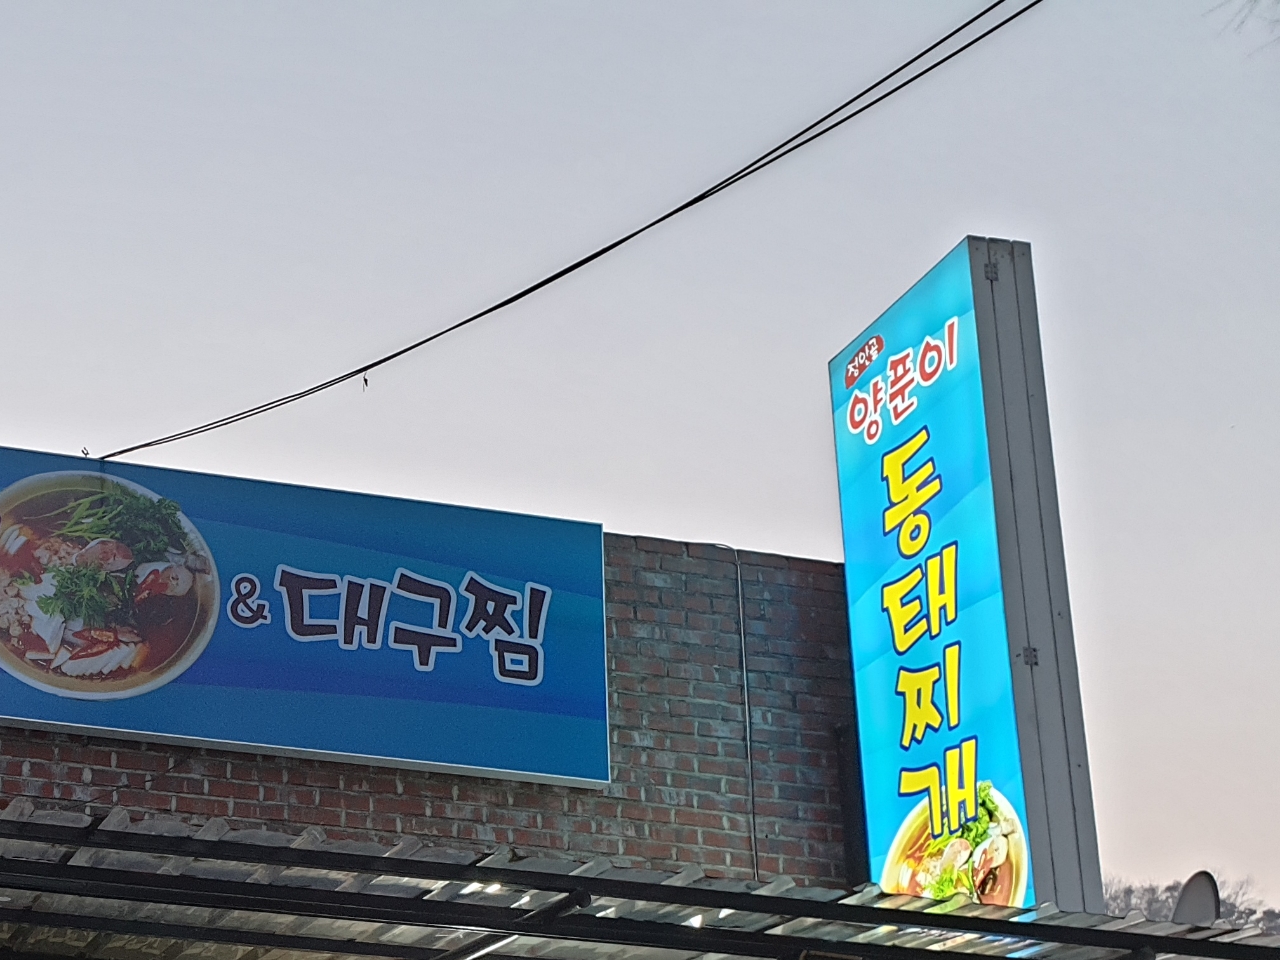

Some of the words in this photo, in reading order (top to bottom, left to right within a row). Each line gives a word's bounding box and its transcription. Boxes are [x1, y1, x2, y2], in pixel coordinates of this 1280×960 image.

[846, 338, 879, 377] 정안골
[846, 316, 960, 445] 양푼이
[227, 573, 272, 629] &
[275, 563, 552, 687] 대구찜
[881, 425, 978, 839] 동태찌개
